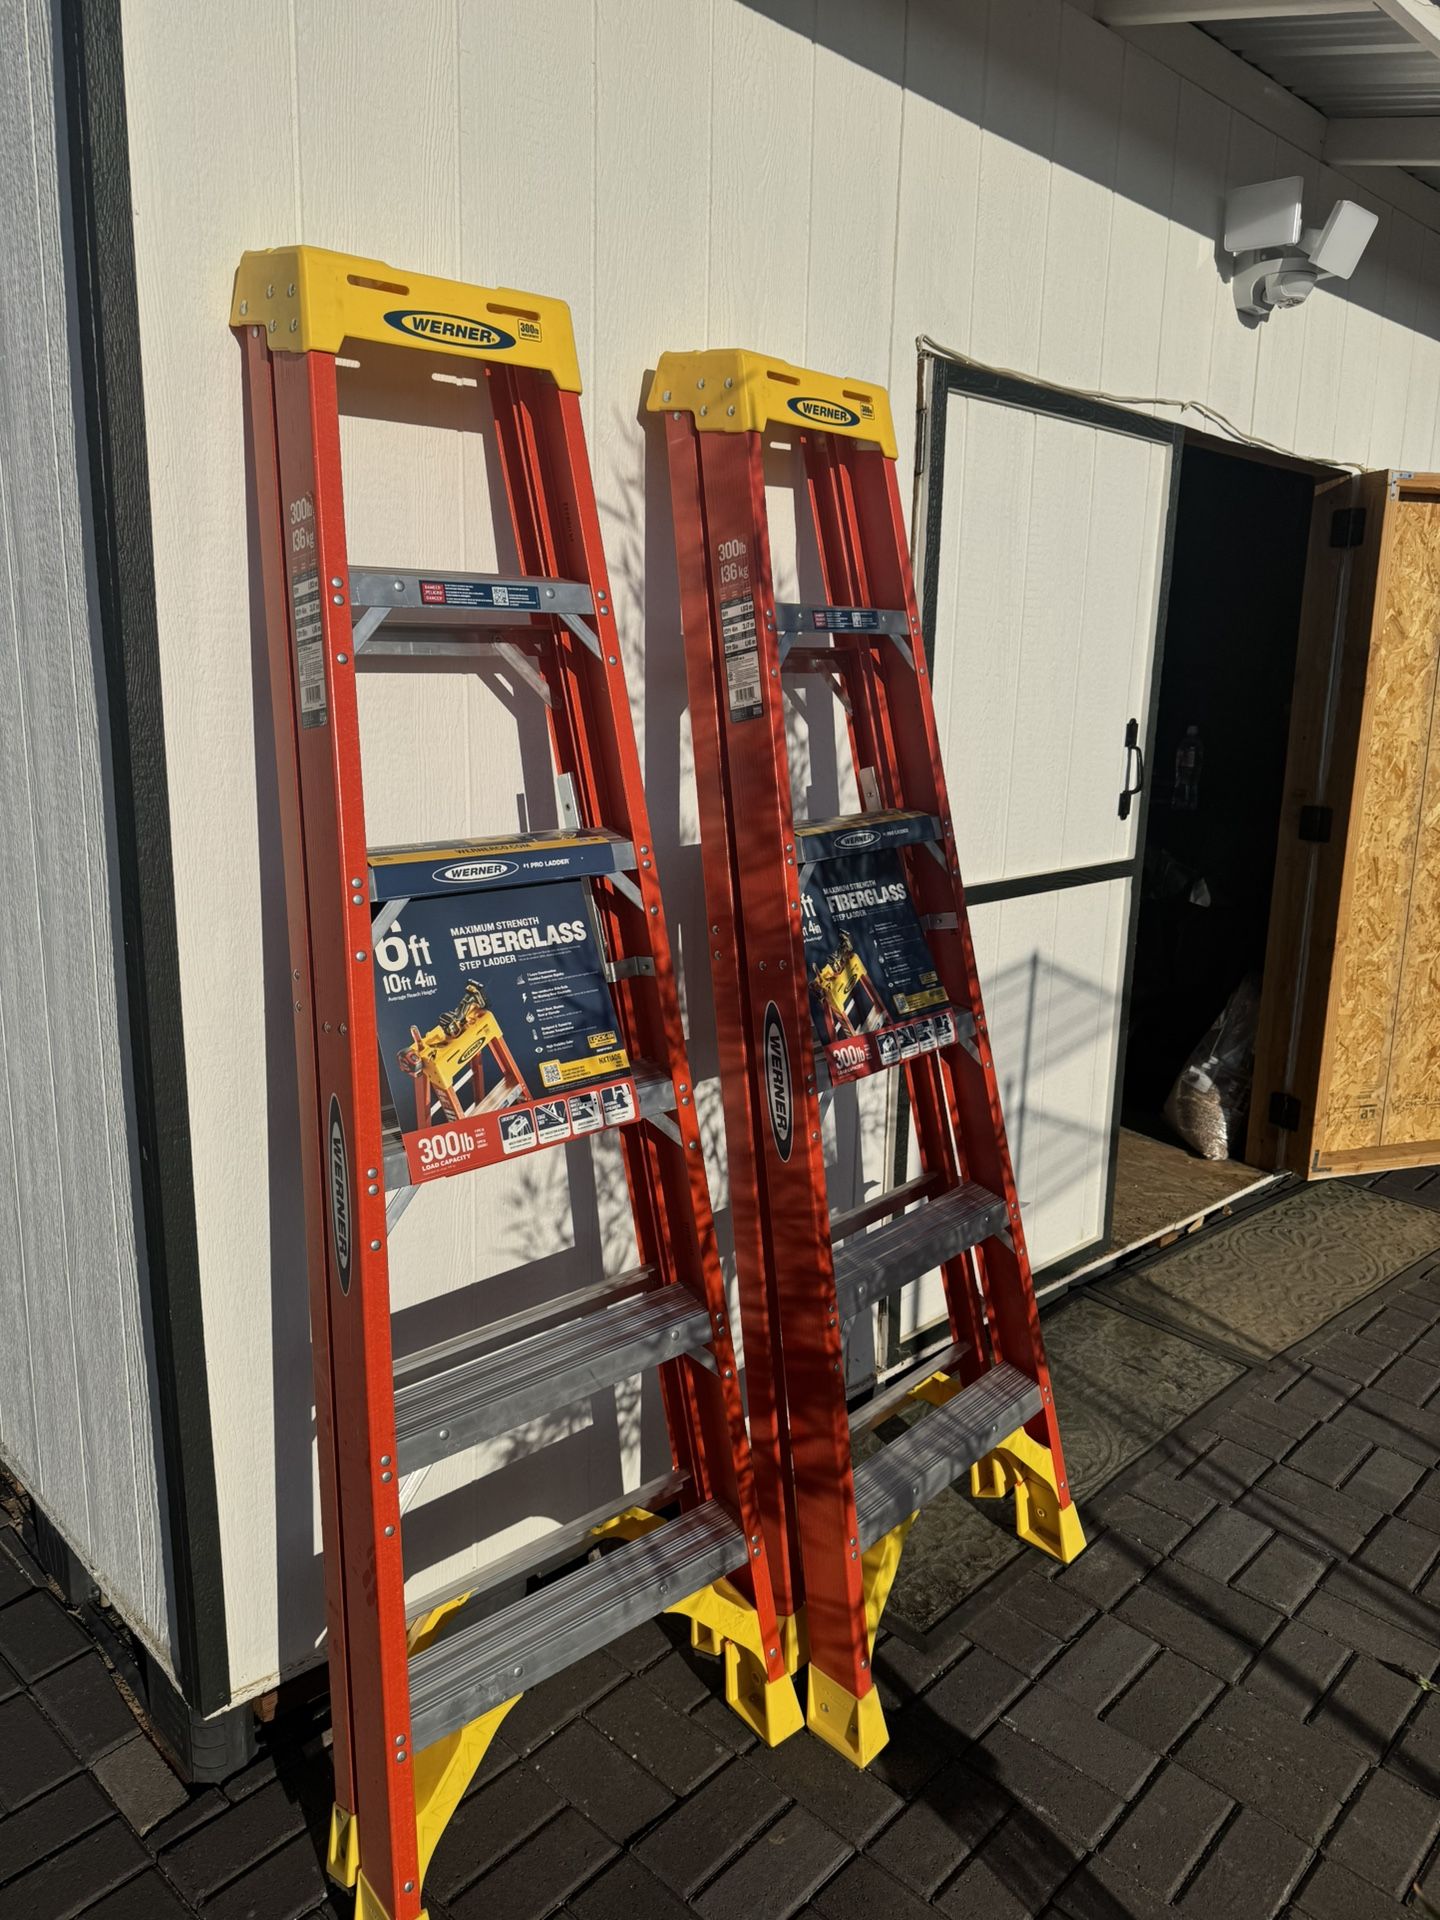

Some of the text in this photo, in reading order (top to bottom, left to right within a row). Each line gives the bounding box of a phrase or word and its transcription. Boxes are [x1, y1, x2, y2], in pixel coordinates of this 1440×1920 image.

[411, 316, 493, 344] WERNER
[802, 402, 847, 422] WERNER
[718, 538, 747, 562] 300lb
[720, 564, 749, 584] 136 kg
[843, 834, 873, 845] WERNER
[451, 864, 503, 879] WERNER
[544, 859, 569, 868] LADDER
[800, 892, 817, 918] ft
[826, 882, 907, 914] FIBERGLASS
[450, 916, 539, 937] MAXIMUM STRENGTH
[454, 920, 587, 960] FIBERGLASS
[459, 959, 481, 972] STEP
[482, 953, 517, 968] LADDER
[382, 969, 437, 994] 10ft 4in
[832, 1045, 866, 1070] 300lb
[769, 1035, 787, 1132] WERNER
[418, 1129, 474, 1163] 300lb
[421, 1158, 441, 1172] LOAD
[439, 1153, 471, 1168] CAPACITY
[332, 1137, 349, 1258] WERNER
